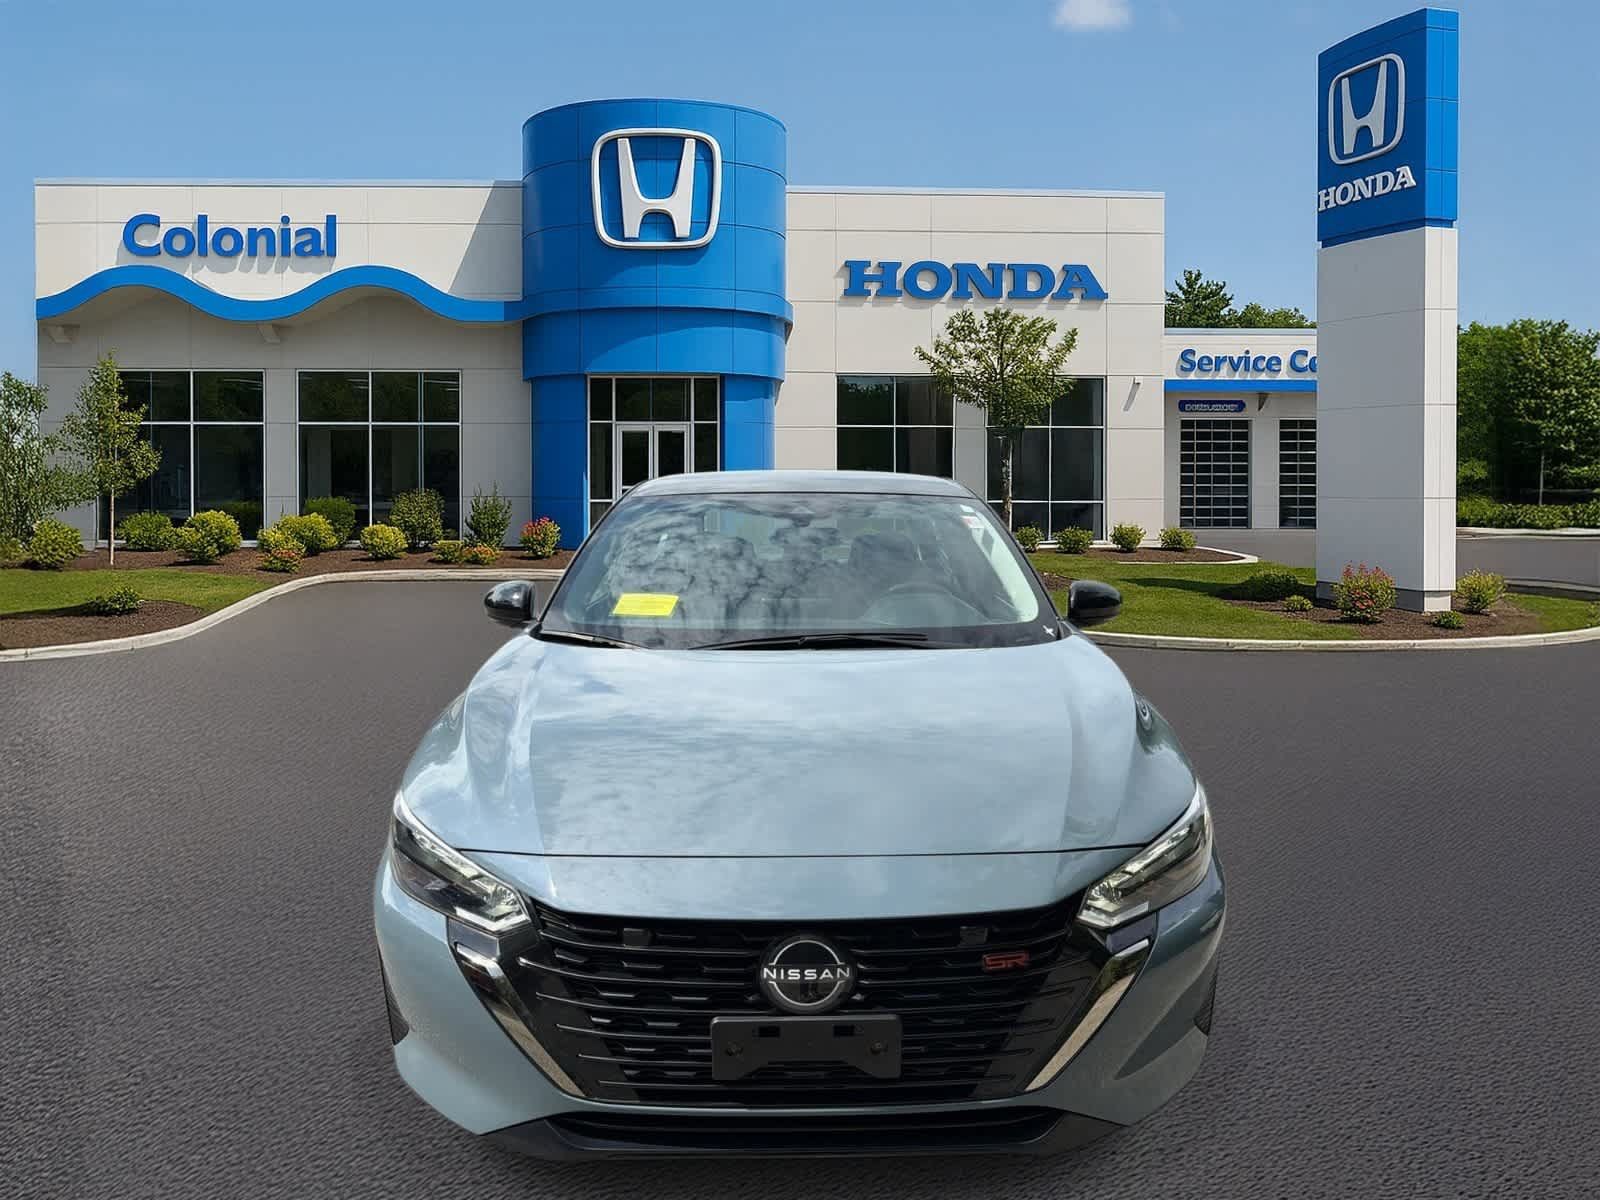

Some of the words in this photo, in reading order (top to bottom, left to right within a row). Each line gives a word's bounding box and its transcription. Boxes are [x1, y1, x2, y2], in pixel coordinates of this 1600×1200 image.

[1317, 165, 1417, 212] HONDA
[122, 213, 338, 257] Colonial
[843, 260, 1108, 300] HONDA
[1179, 348, 1282, 373] Service
[762, 966, 851, 981] NISSAN
[983, 953, 1029, 970] SR
